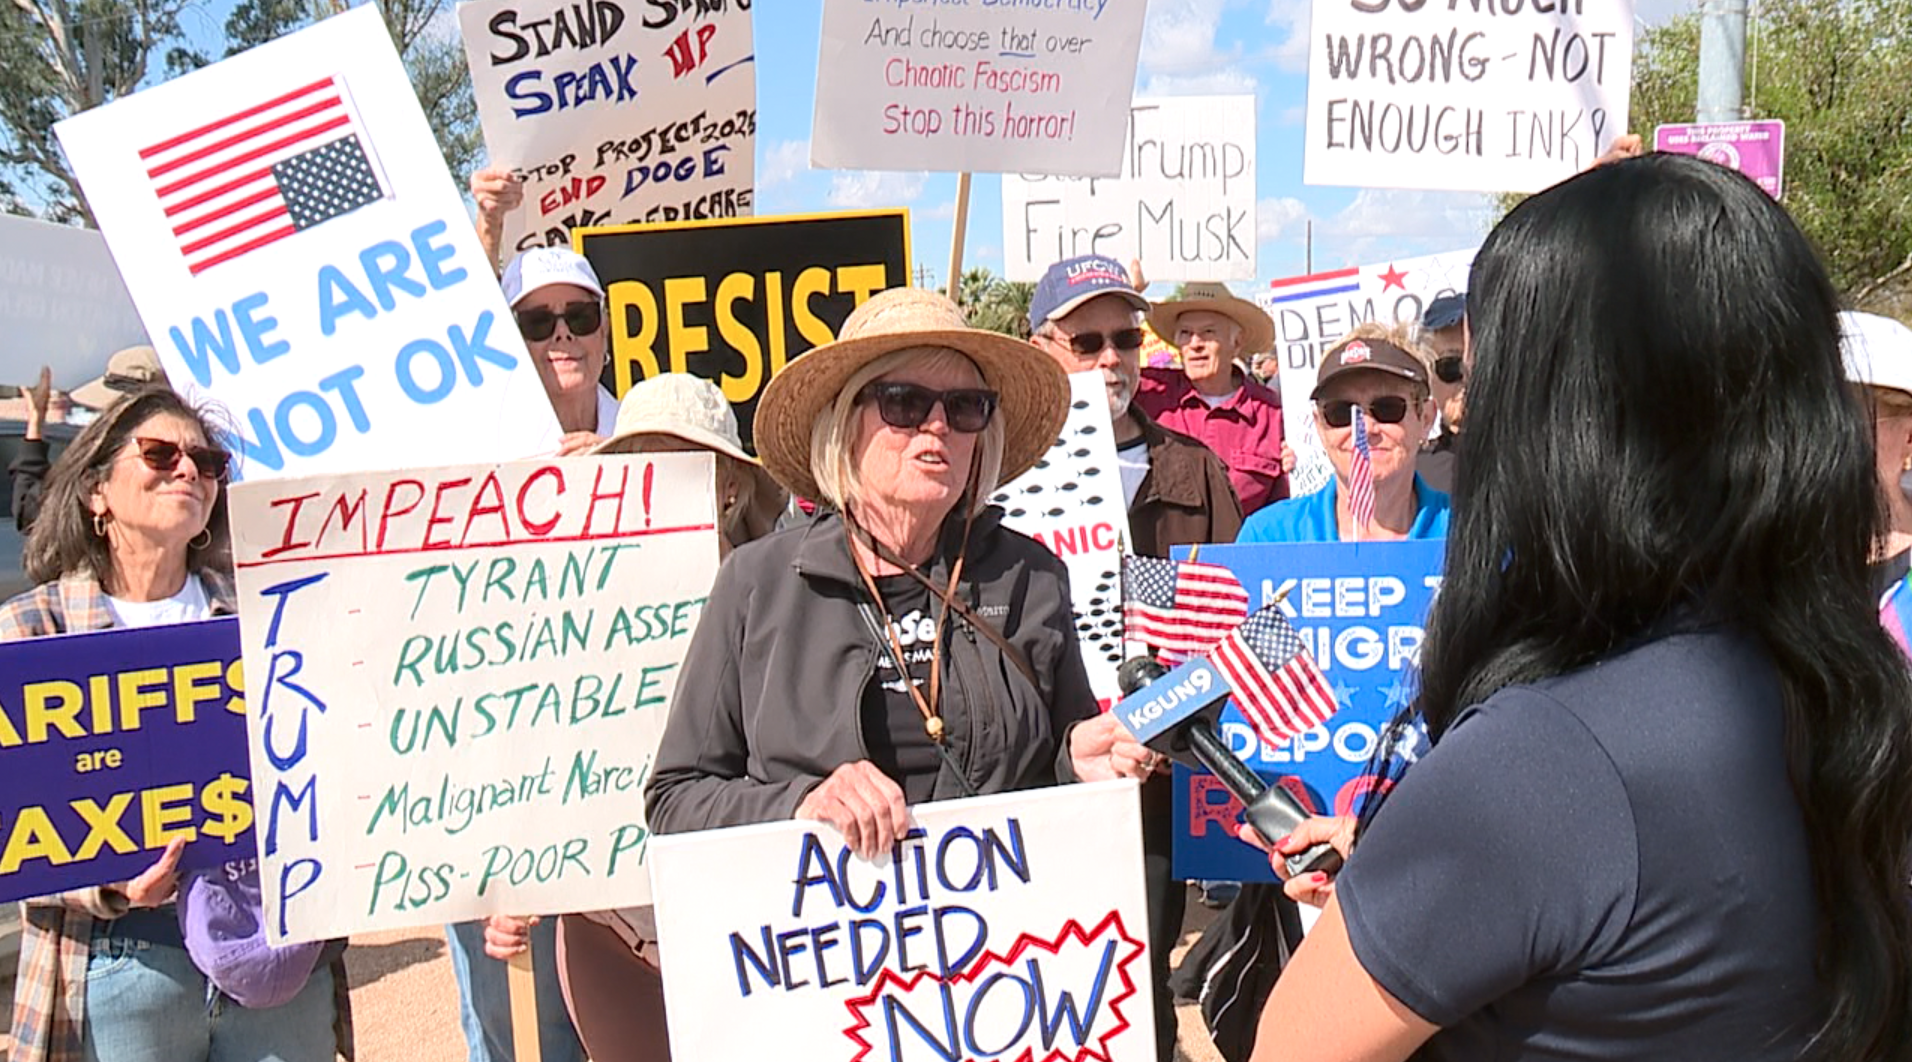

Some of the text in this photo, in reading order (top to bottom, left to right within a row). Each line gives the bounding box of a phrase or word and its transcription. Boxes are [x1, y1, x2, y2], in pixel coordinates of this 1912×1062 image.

[488, 0, 625, 66] STAND
[864, 15, 1092, 54] And choose that over
[1326, 27, 1490, 85] WRONG
[1528, 27, 1616, 86] NOT
[504, 23, 716, 118] SPEAK UP
[885, 58, 1061, 94] Chaotic Fascism
[593, 110, 707, 170] PROJECT
[883, 101, 1077, 141] Stop this horror!
[1327, 98, 1484, 156] ENOUGH
[540, 144, 732, 217] END DOGE
[622, 188, 753, 225] EDICARE
[1026, 199, 1123, 263] Fire
[169, 292, 290, 388] WE
[318, 219, 468, 336] ARE
[607, 263, 886, 402] RESIST
[1281, 287, 1457, 342] DEMO
[226, 310, 518, 482] NOT OK
[261, 461, 654, 558] IMPEACH!
[405, 543, 642, 621] TYRANT
[1261, 576, 1406, 618] KEEP
[389, 662, 679, 755] UNSTABLE
[1127, 667, 1213, 731] KGUN9
[75, 748, 123, 774] are
[260, 571, 330, 938] TRUMP
[366, 755, 556, 836] Malignant
[791, 817, 1031, 918] ACTION
[728, 904, 989, 998] NEEDED
[882, 938, 1118, 1062] NOW
